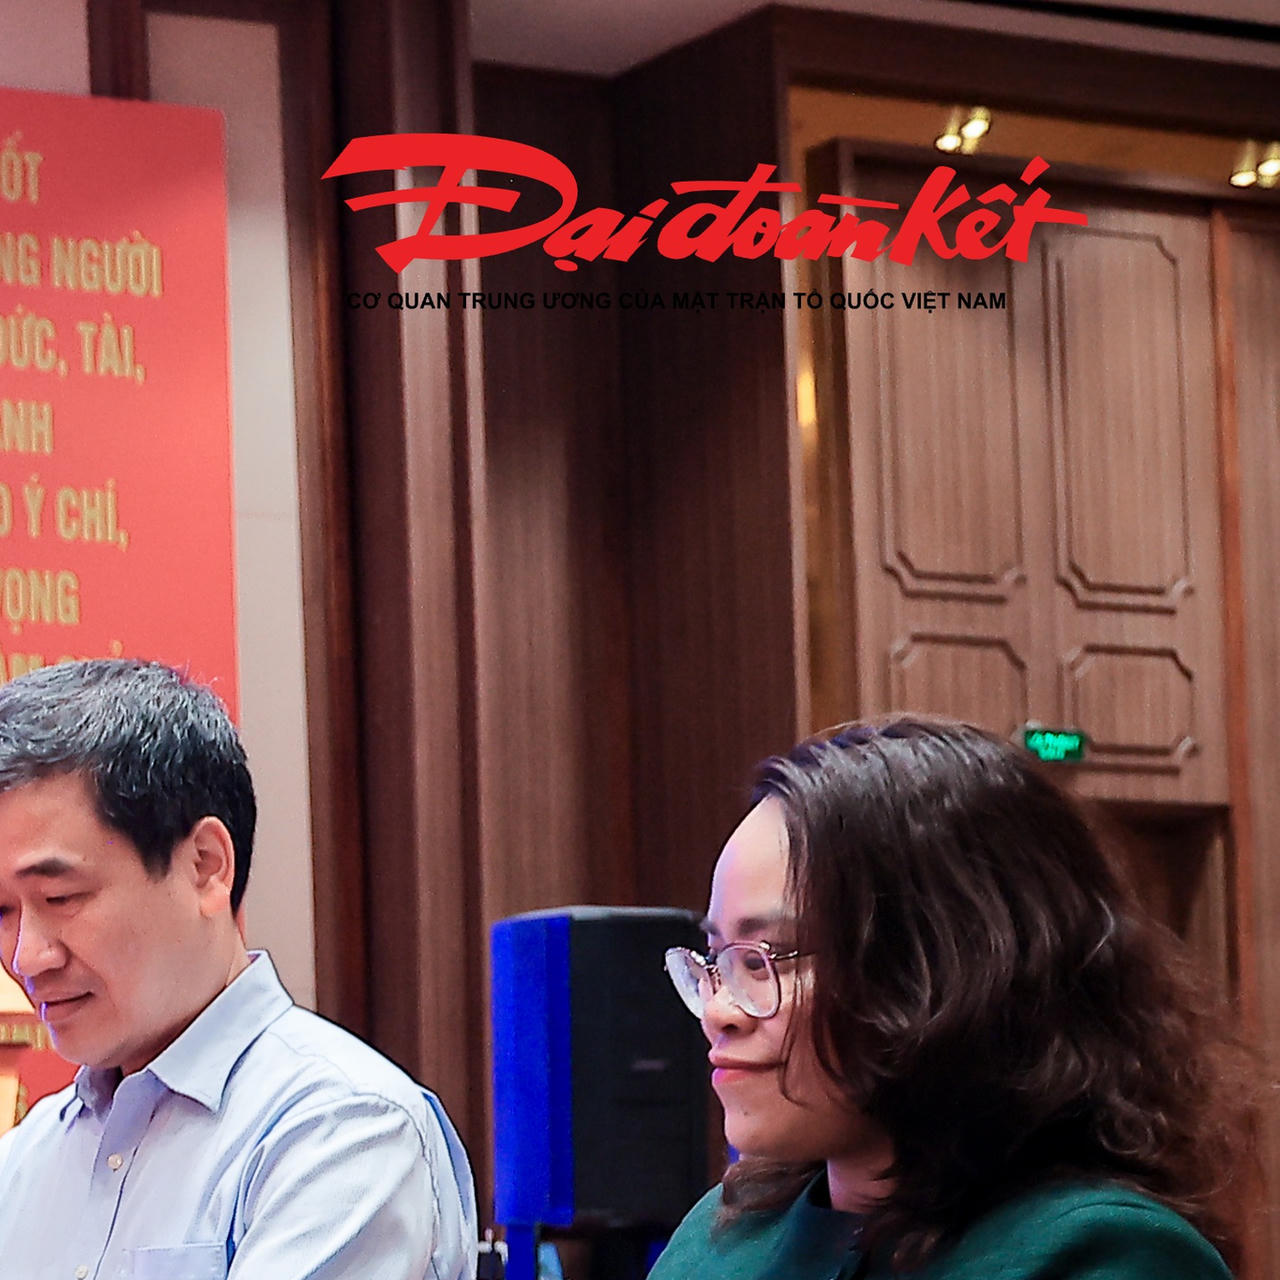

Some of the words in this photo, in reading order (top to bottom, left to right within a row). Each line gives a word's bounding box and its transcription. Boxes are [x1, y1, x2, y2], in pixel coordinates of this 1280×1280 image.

[51, 229, 162, 297] NGƯỜI
[77, 312, 146, 384] TÀI,
[22, 473, 44, 538] Ý
[55, 478, 129, 551] CHÍ,
